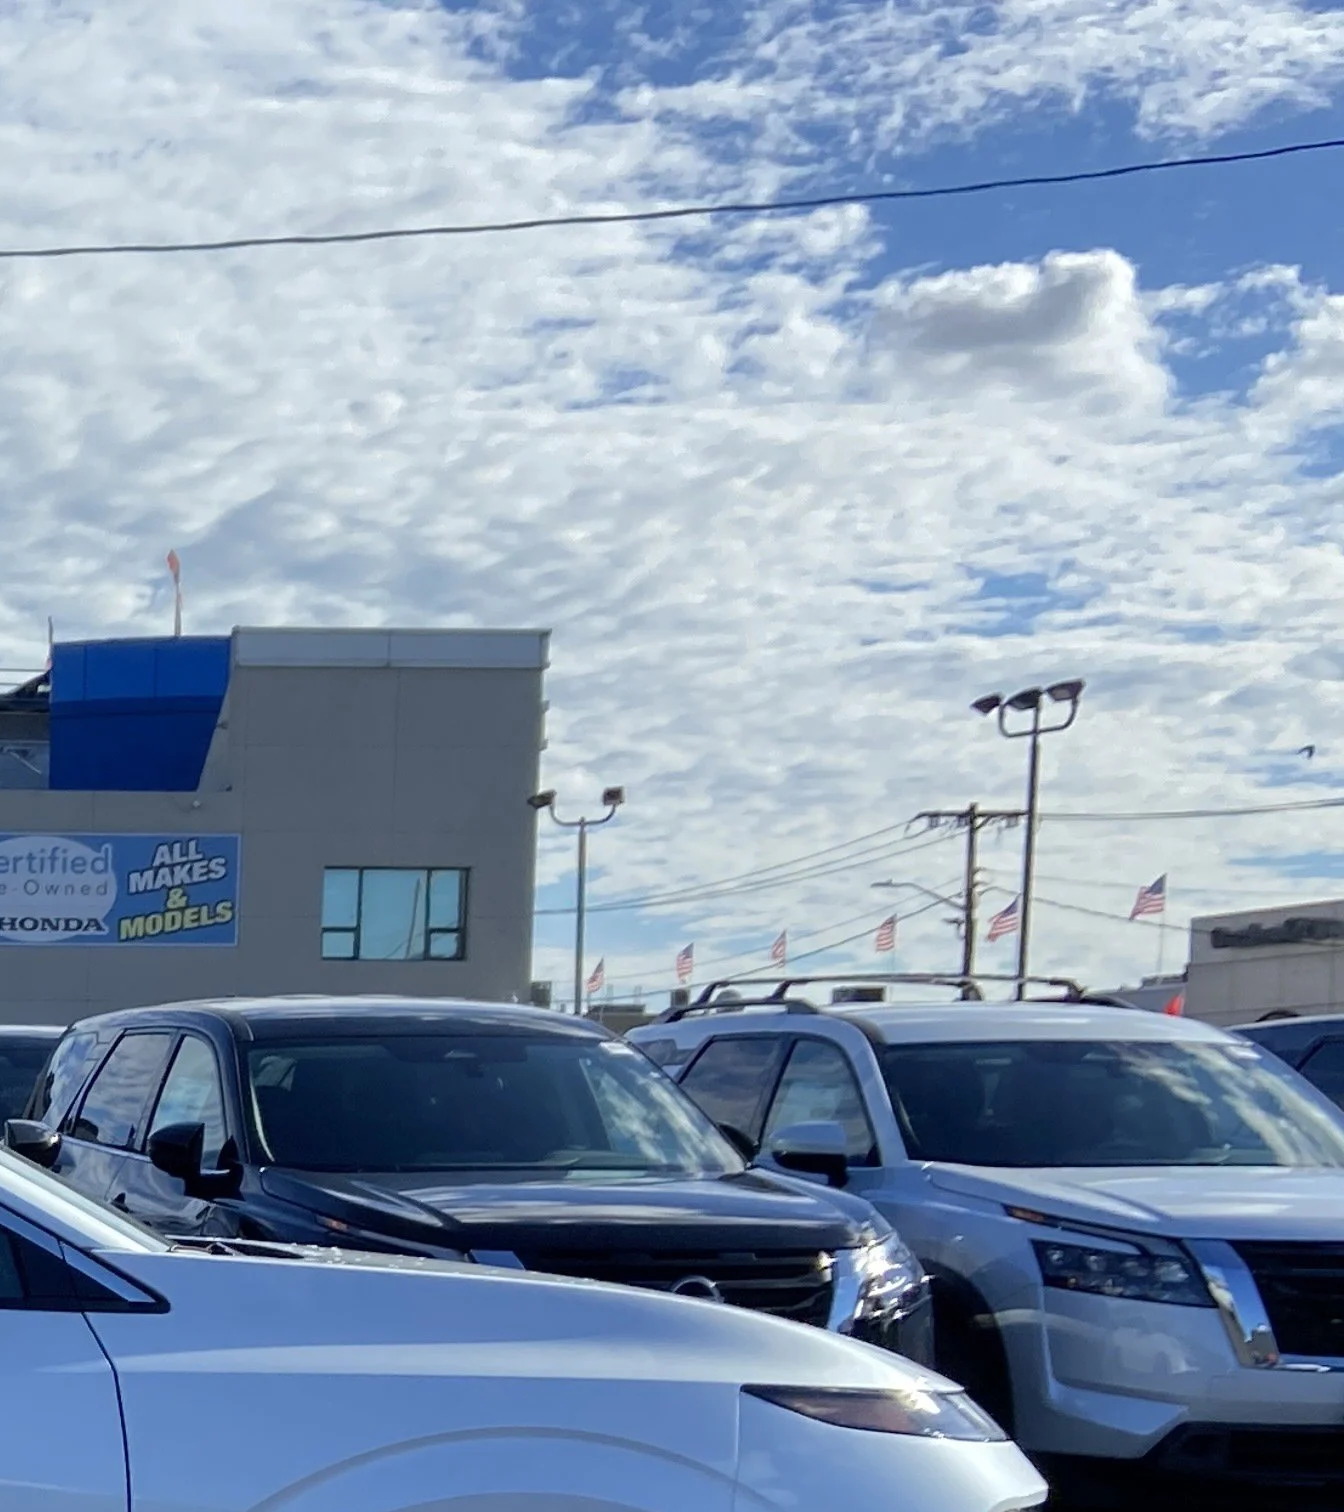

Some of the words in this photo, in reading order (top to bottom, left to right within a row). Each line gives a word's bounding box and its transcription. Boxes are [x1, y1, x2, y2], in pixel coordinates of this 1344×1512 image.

[153, 840, 204, 867] ALL
[129, 857, 227, 893] MAKES
[166, 887, 188, 910] &
[119, 901, 233, 940] MODELS
